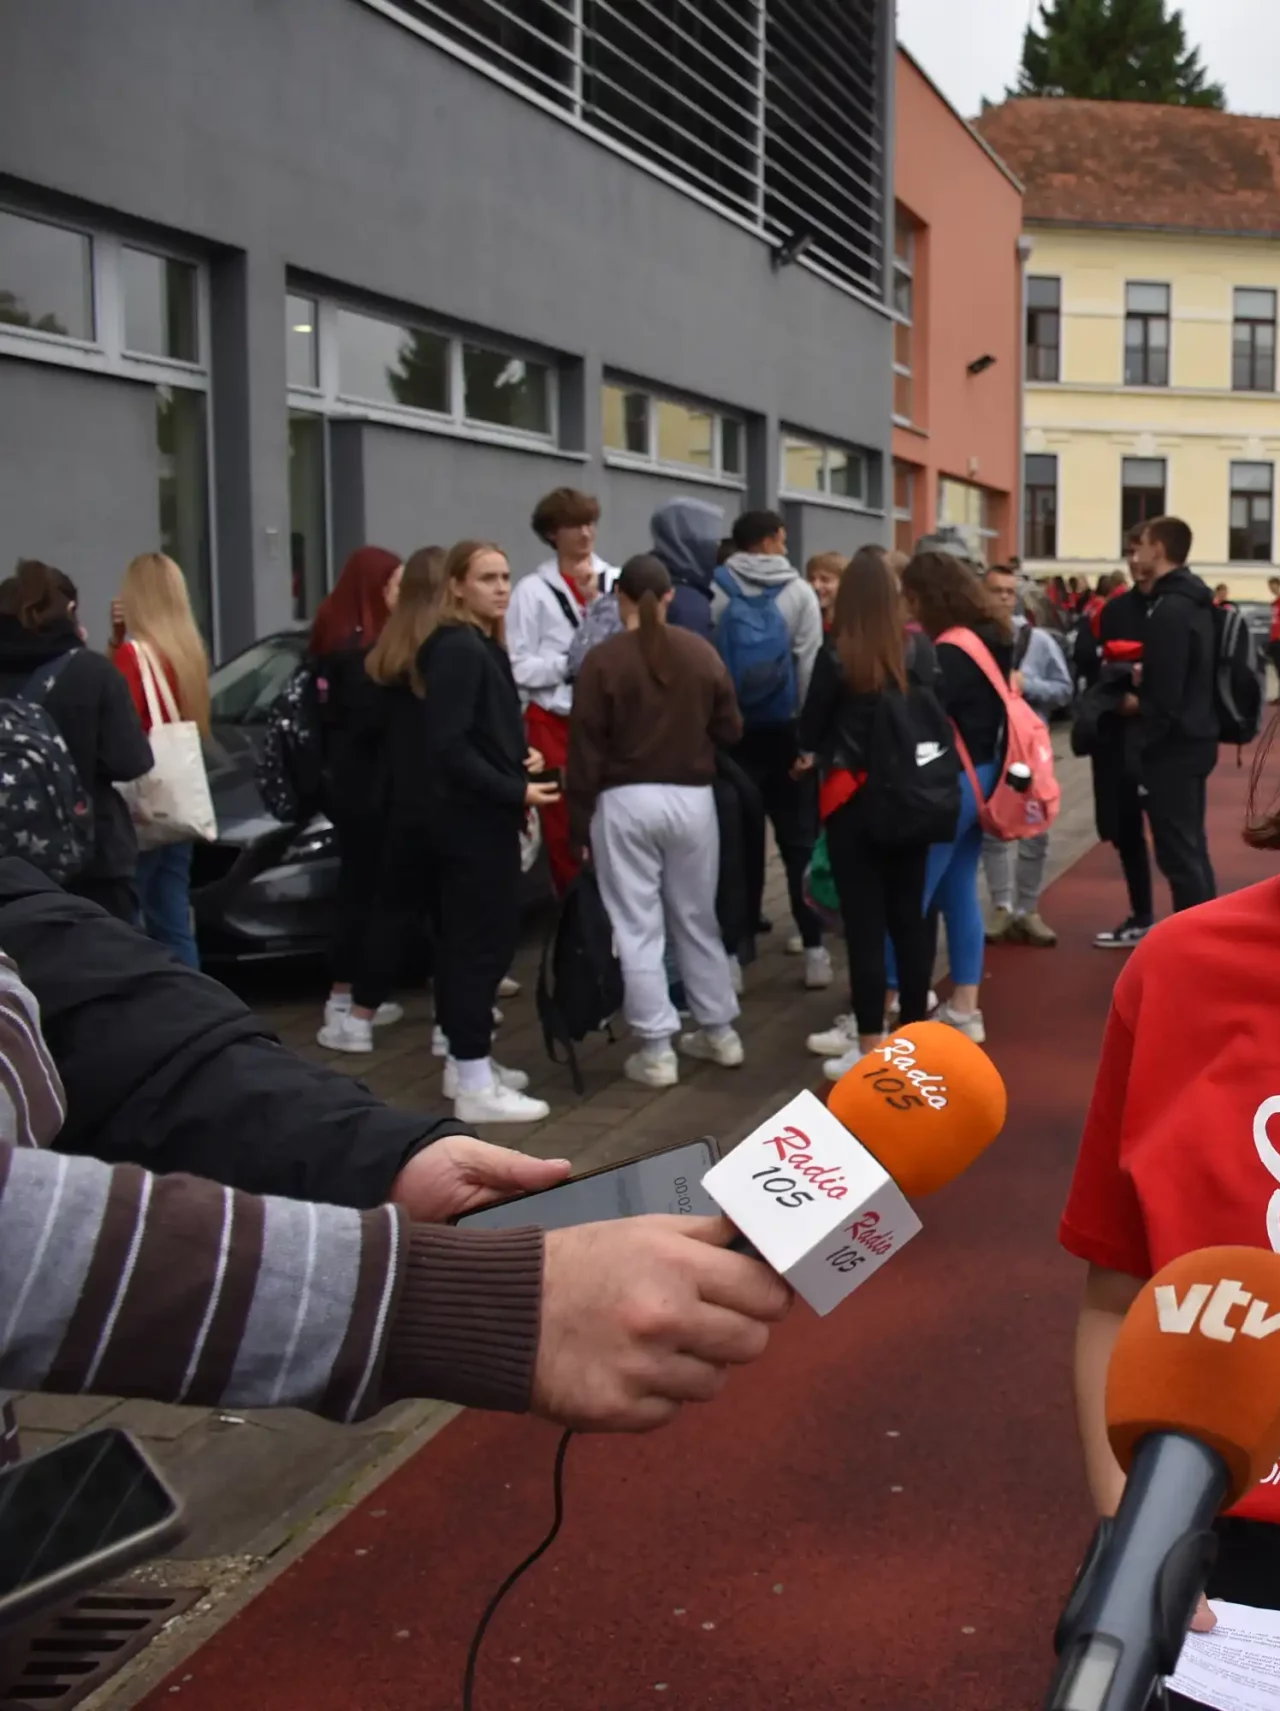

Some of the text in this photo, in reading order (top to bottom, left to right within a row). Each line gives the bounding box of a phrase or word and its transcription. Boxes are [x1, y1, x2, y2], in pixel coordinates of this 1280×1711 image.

[863, 1067, 925, 1111] 105
[875, 1038, 949, 1110] Radio
[762, 1126, 849, 1200] Radio
[752, 1166, 815, 1208] 105
[844, 1211, 894, 1256] Radio
[825, 1245, 866, 1273] 105
